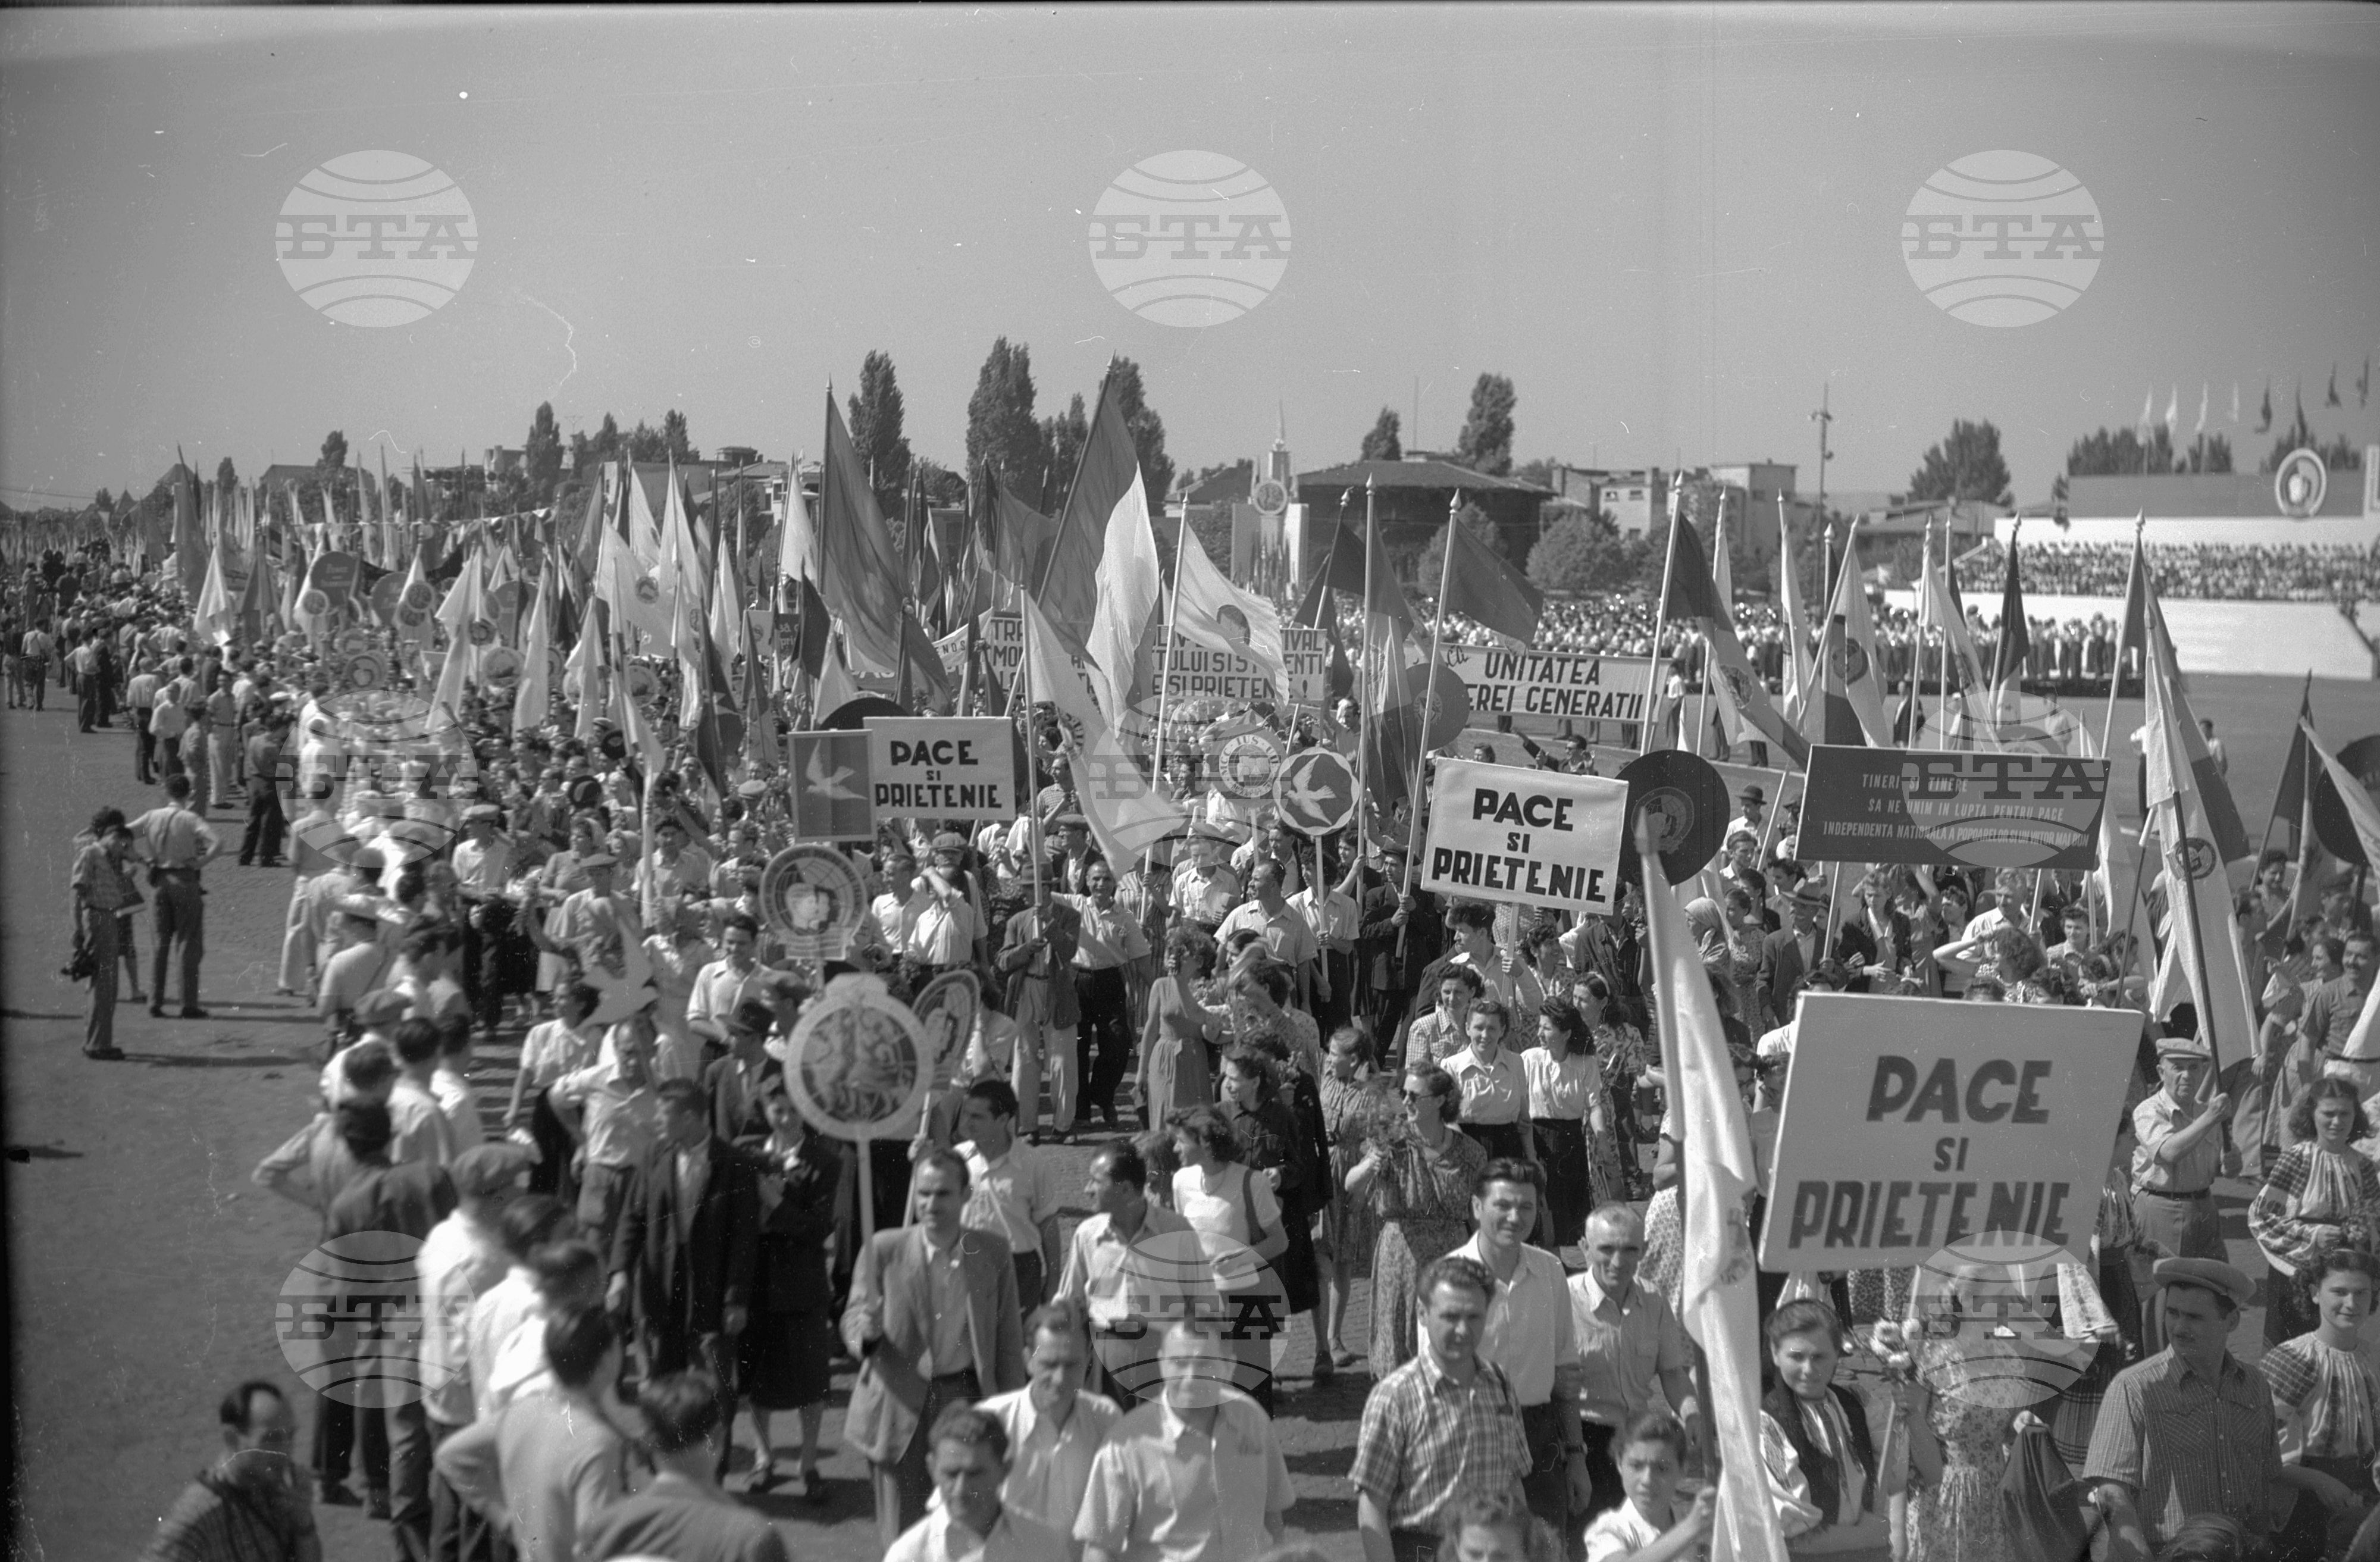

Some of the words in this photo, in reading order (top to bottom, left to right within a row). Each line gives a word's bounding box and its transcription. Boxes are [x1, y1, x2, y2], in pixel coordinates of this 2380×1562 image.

[1485, 652, 1599, 685] UNITATEA
[1526, 686, 1643, 719] GENERATII
[890, 740, 978, 766] PACE
[927, 769, 941, 781] SI
[1862, 774, 1900, 789] TINERI
[1928, 777, 1969, 793] TINERE
[876, 783, 1002, 809] PRIETENIE
[1473, 788, 1573, 831] PACE
[1868, 798, 1881, 813] SA
[1887, 799, 1902, 813] NE
[1907, 800, 1933, 815] UNIM
[1938, 802, 1950, 816] IN
[1955, 803, 1986, 817] LUPTA
[1994, 805, 2034, 819] PENTRU
[2038, 807, 2065, 821] PACE
[1507, 831, 1530, 853] SI
[1823, 821, 1893, 838] INDEPENDENTA
[1897, 825, 1946, 840] NATIONALA
[1432, 847, 1606, 903] PRIETENIE
[1866, 1056, 2053, 1124] PACE
[1934, 1137, 1969, 1172] SI
[1788, 1180, 2069, 1248] PRIETENIE
